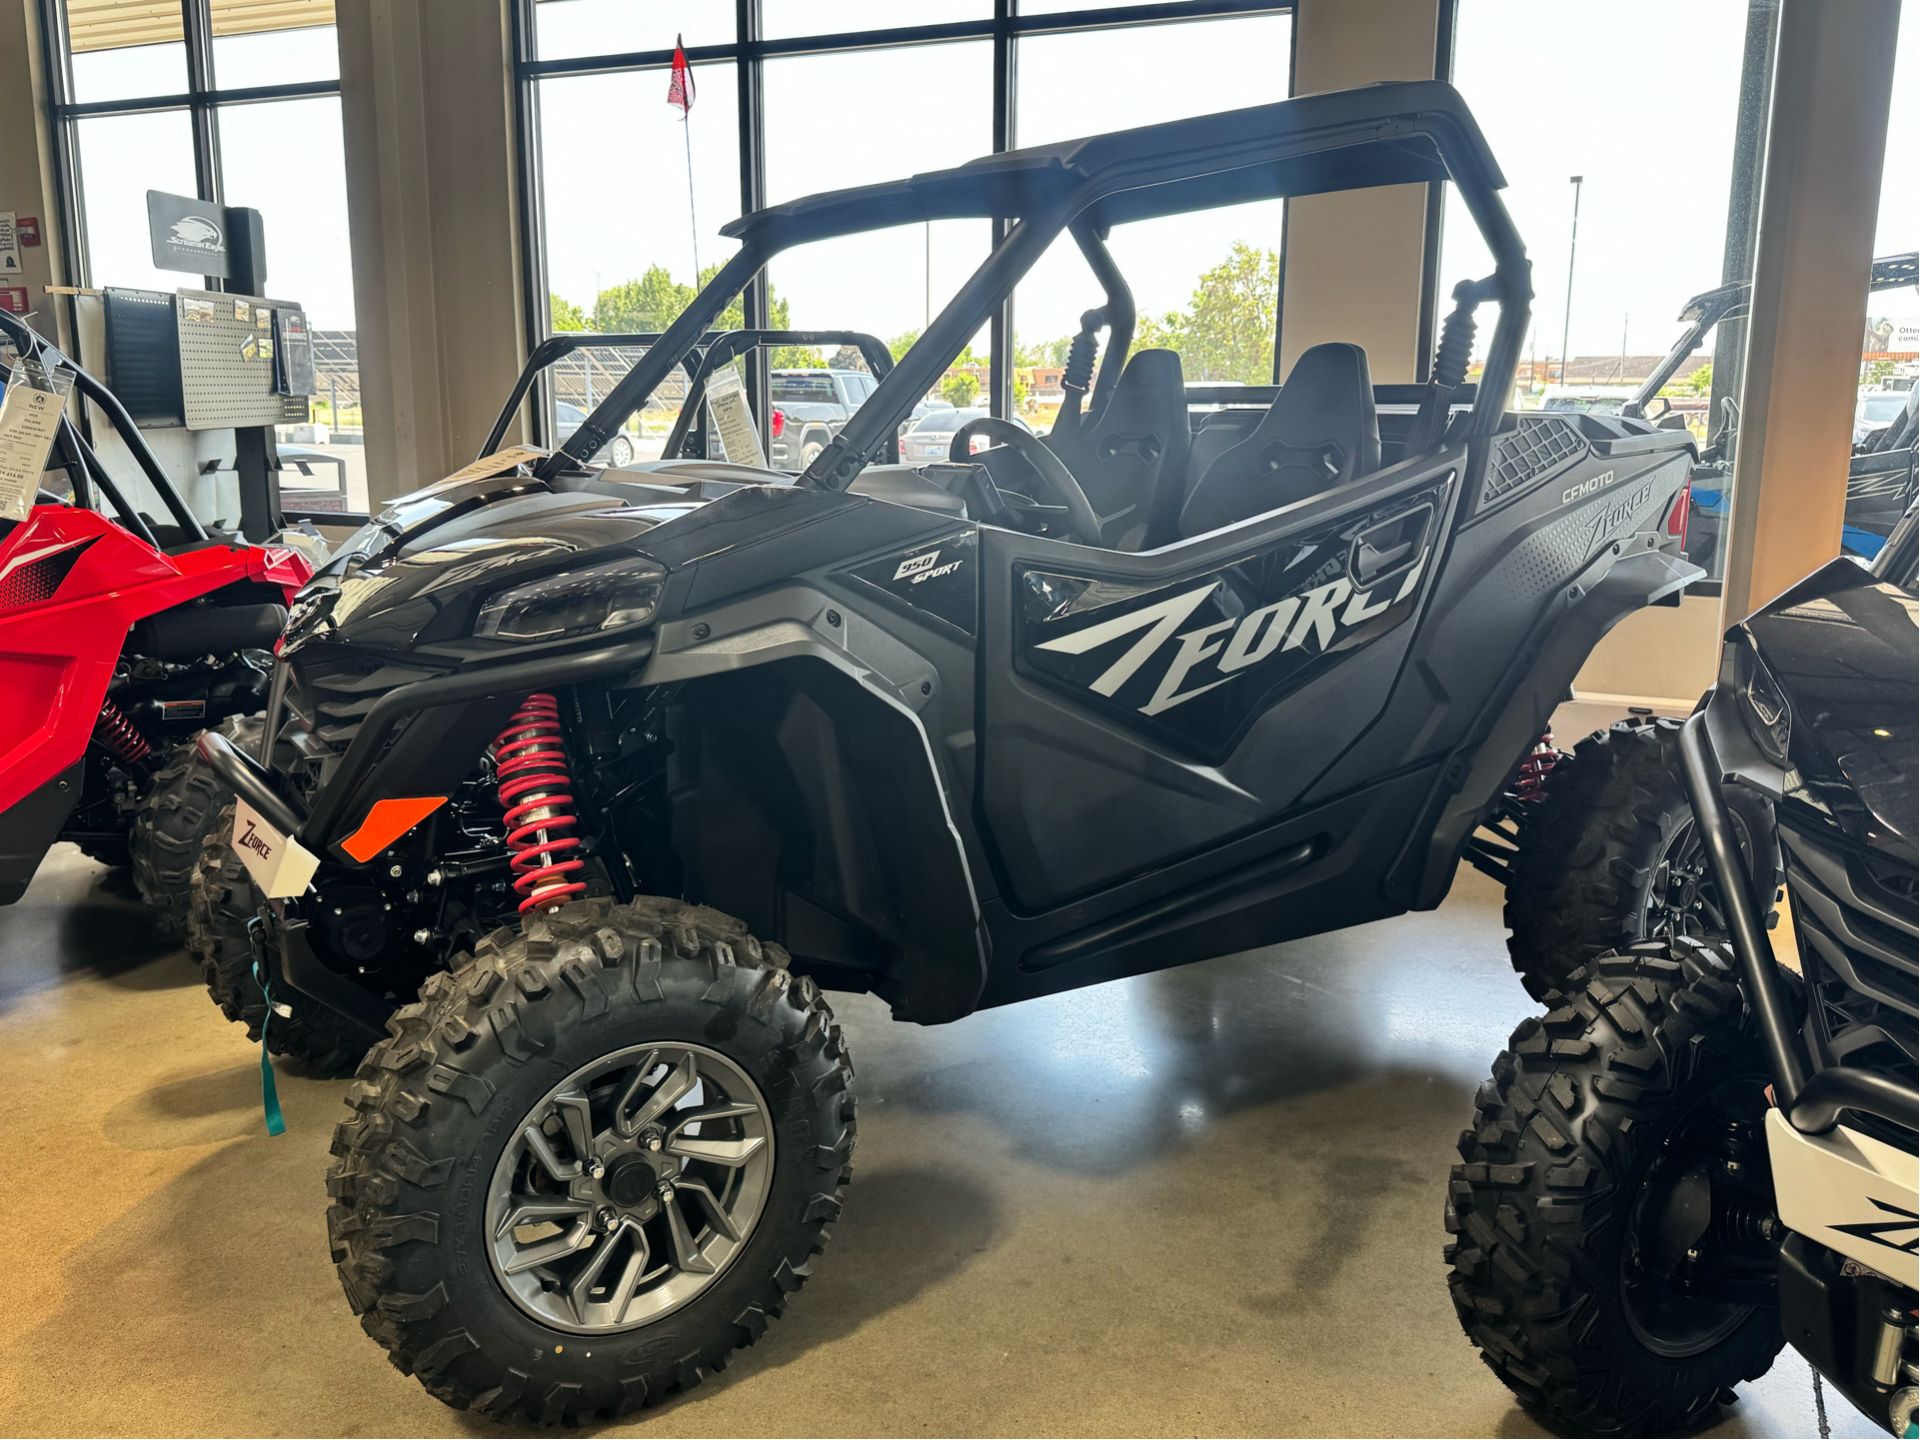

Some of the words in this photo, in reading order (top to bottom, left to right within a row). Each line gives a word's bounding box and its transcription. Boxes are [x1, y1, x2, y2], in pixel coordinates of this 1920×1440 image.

[1562, 470, 1614, 504] CFMOTO
[901, 556, 934, 575] 950
[911, 560, 963, 584] SPORT
[238, 819, 272, 860] ZFORCE
